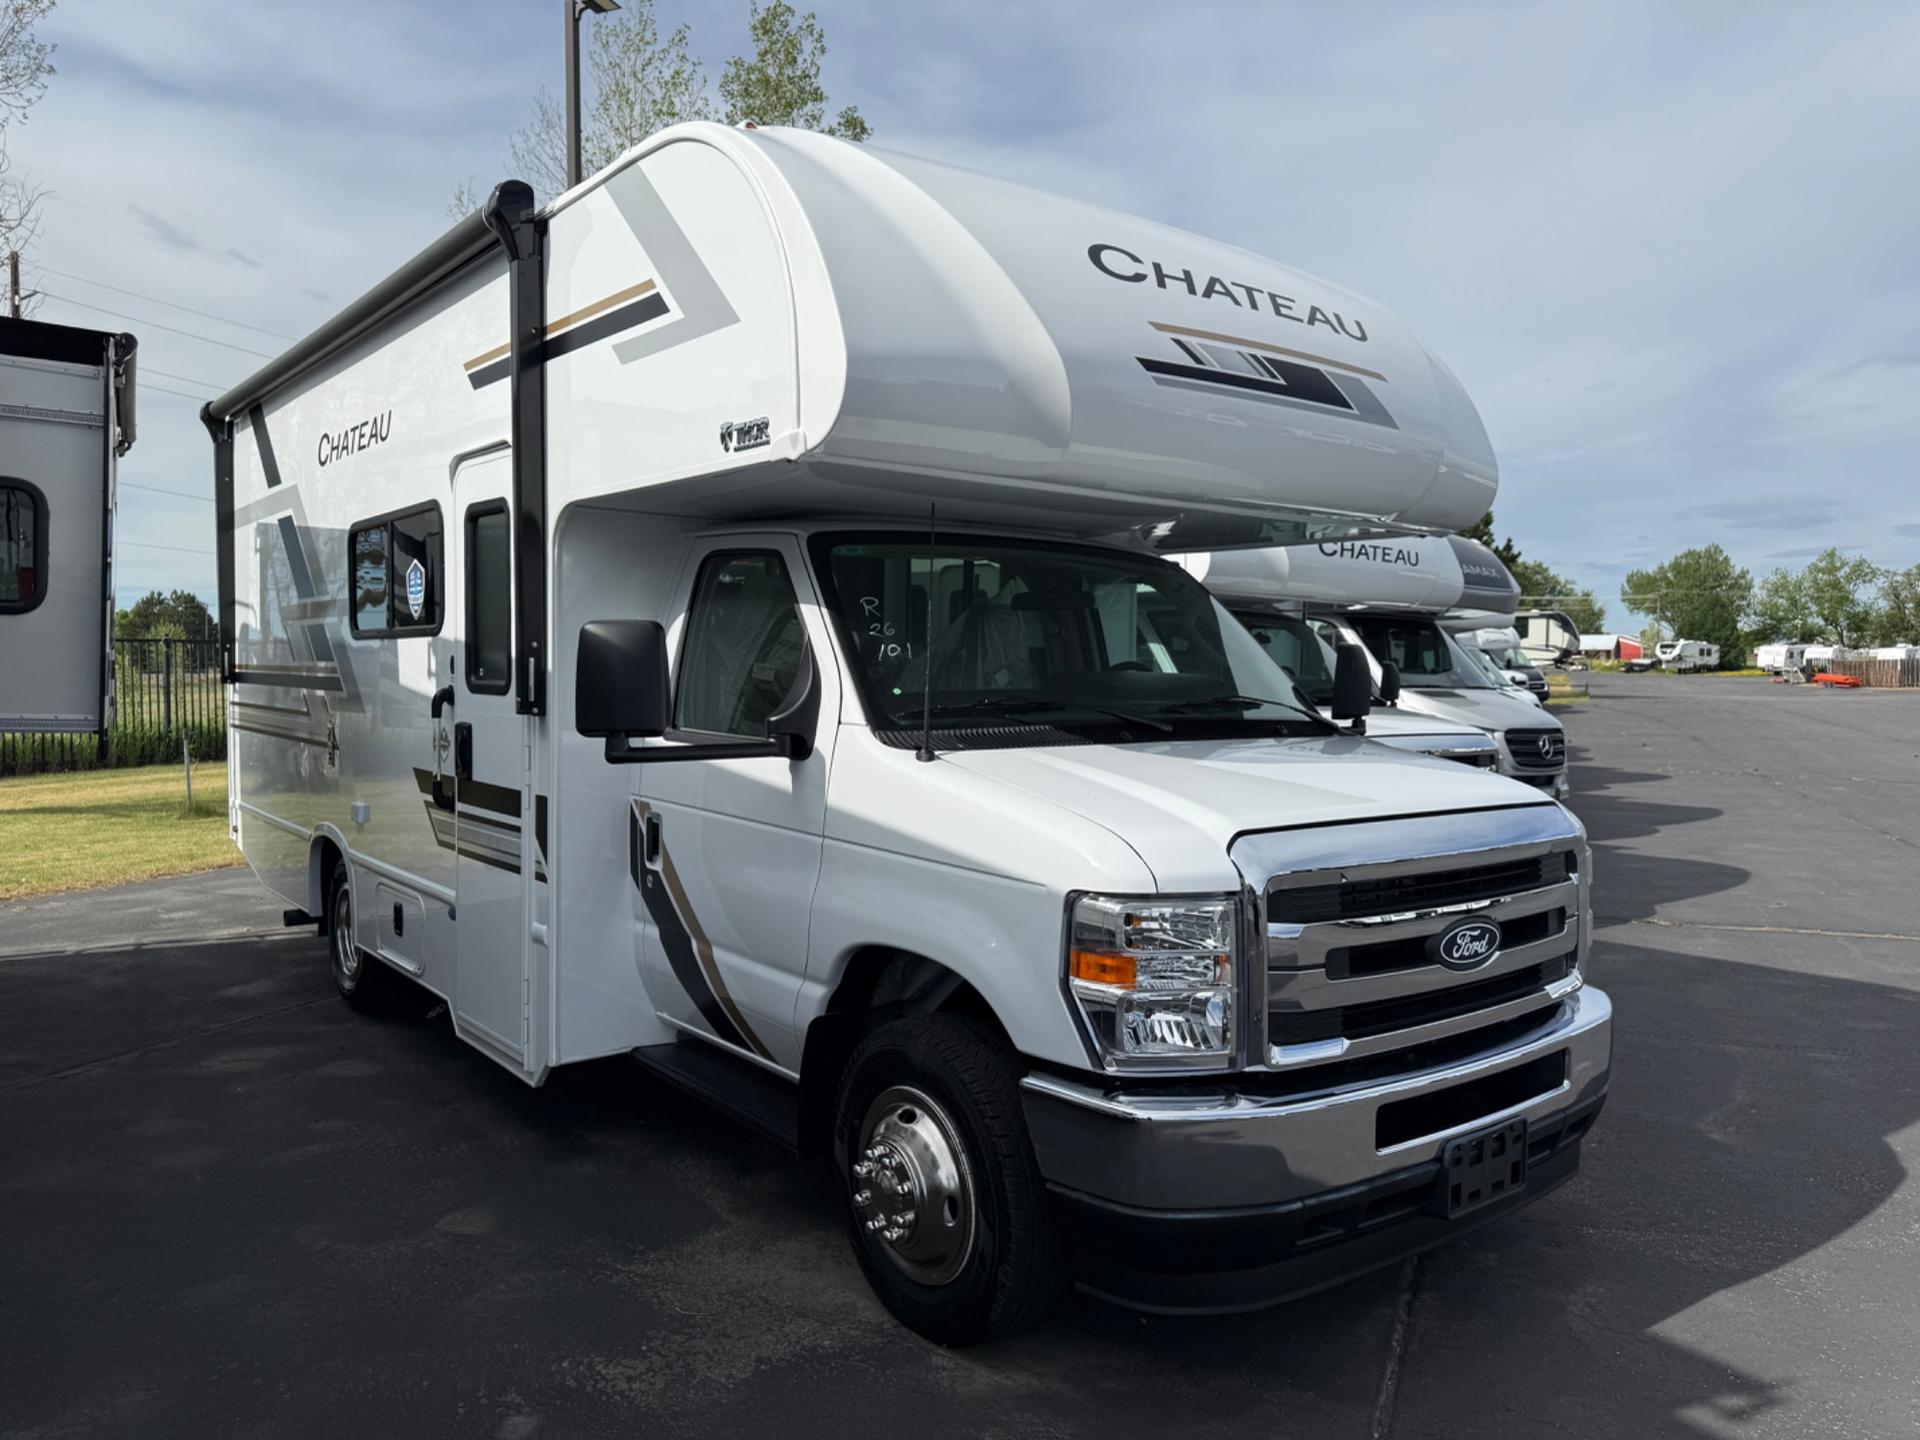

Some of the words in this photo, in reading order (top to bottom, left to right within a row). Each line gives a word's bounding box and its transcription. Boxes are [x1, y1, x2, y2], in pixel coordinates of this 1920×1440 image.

[1087, 243, 1369, 343] CHATEAU
[317, 409, 393, 467] CHATEAU
[734, 416, 770, 445] THOR
[1318, 541, 1420, 567] CHATEAU
[1462, 564, 1501, 579] AMAX
[859, 596, 882, 617] R
[868, 622, 896, 638] 26
[878, 642, 912, 661] 101
[1452, 929, 1490, 958] Ford
